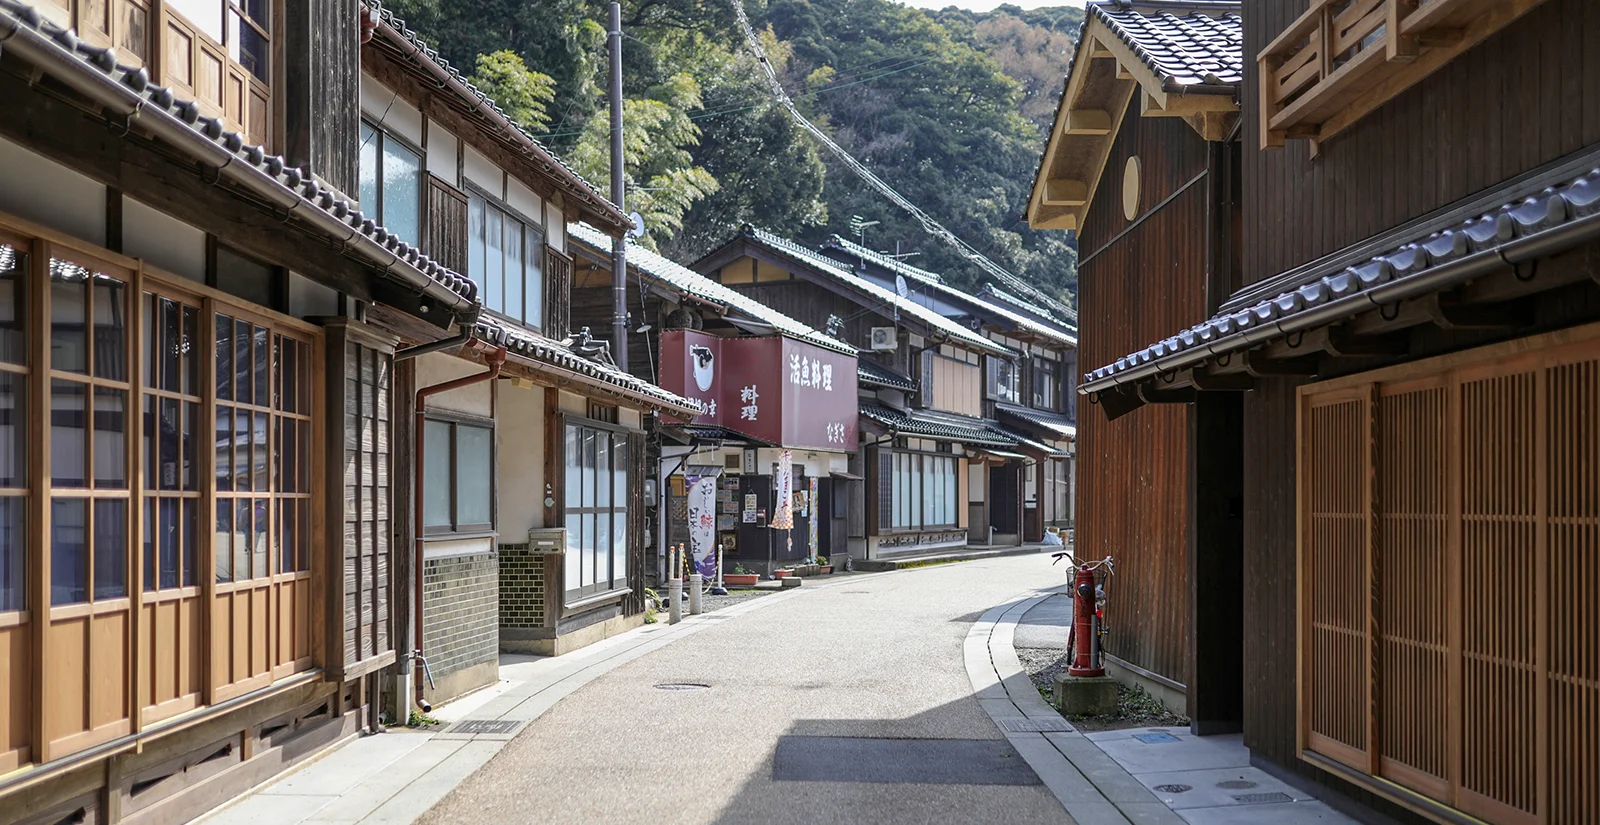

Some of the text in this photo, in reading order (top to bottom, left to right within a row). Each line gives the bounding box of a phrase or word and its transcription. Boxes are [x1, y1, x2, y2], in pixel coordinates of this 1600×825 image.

[790, 354, 832, 391] 活魚料理
[740, 385, 759, 420] 料理
[827, 423, 844, 443] なぎさ
